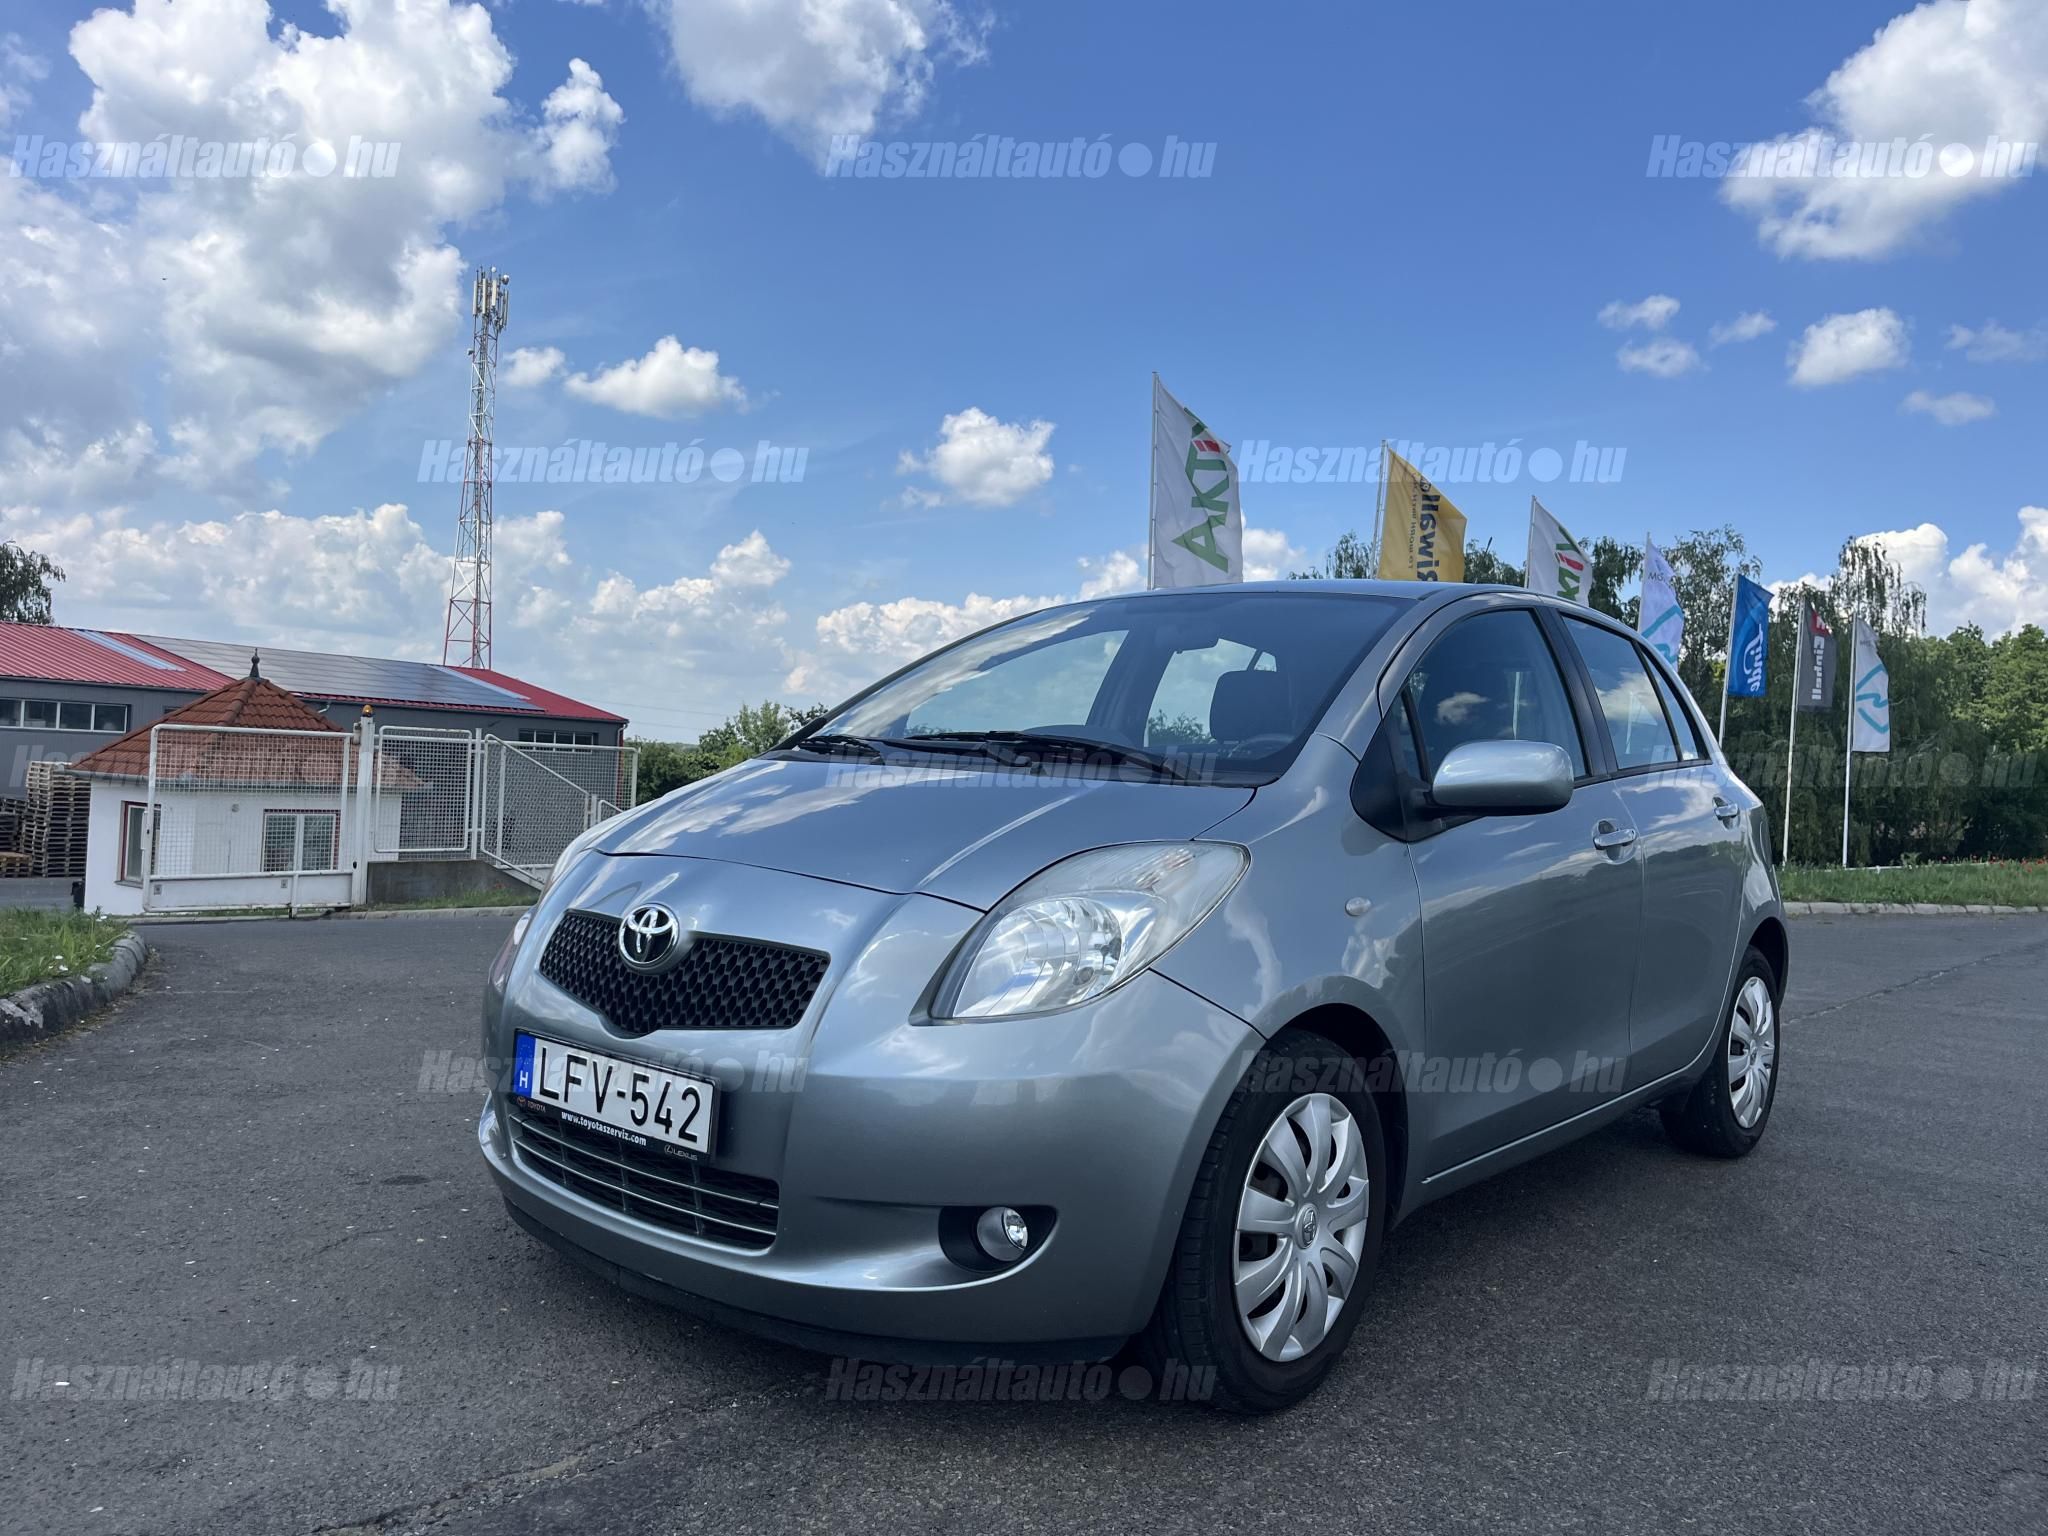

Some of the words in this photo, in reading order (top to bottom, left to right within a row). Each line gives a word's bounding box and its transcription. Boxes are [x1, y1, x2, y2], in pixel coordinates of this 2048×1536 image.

[518, 1070, 529, 1089] H
[527, 1100, 547, 1113] TOYOTA
[538, 1046, 701, 1144] LFV-542
[561, 1110, 647, 1146] www.toyotaszerviz.com
